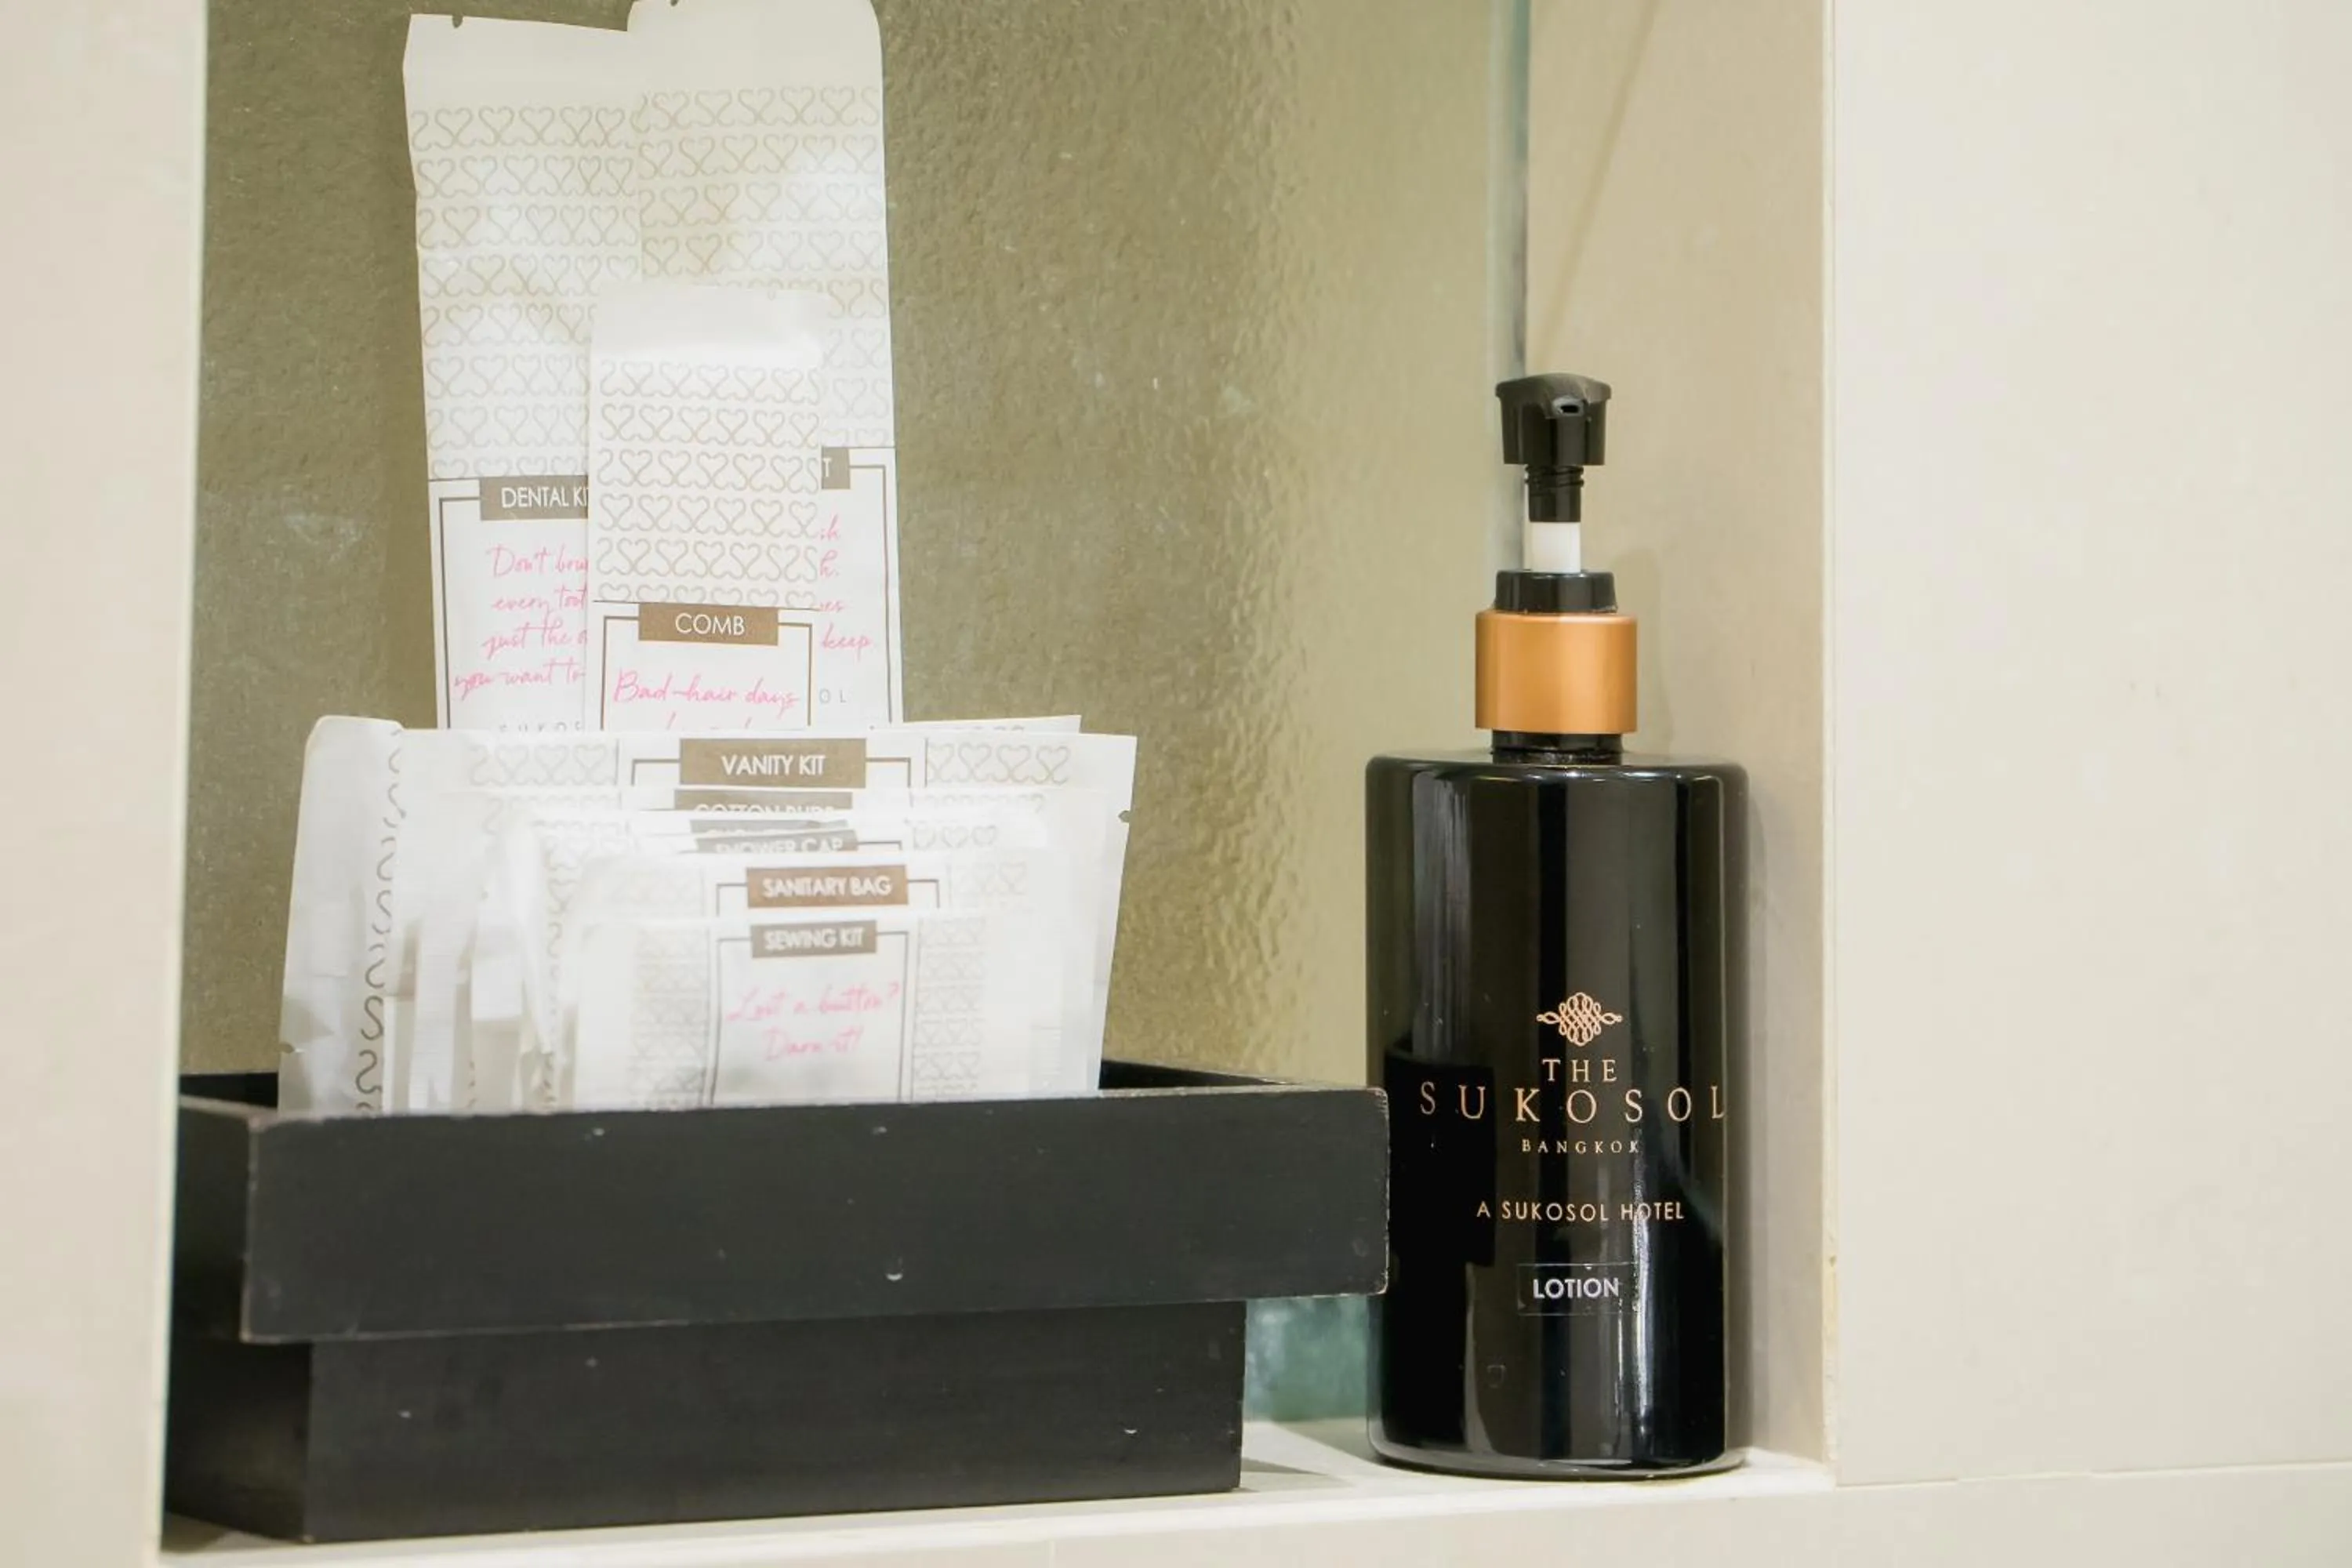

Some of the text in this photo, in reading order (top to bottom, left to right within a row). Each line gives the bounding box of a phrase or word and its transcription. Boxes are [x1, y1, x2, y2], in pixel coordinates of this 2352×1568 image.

[501, 486, 569, 508] DENTAL
[675, 612, 746, 637] COMB
[481, 621, 535, 660] just
[538, 617, 572, 648] the
[745, 676, 800, 720] days
[721, 754, 826, 775] VANITY KIT
[762, 875, 893, 898] SANITARY BAG
[764, 926, 865, 950] SEWING KIT
[1541, 1059, 1617, 1082] THE
[1420, 1080, 1725, 1124] SUKOSOL
[1522, 1139, 1640, 1155] BANGKOK
[1476, 1201, 1685, 1222] A SUKOSOL HOTEL
[1533, 1277, 1620, 1299] LOTION
